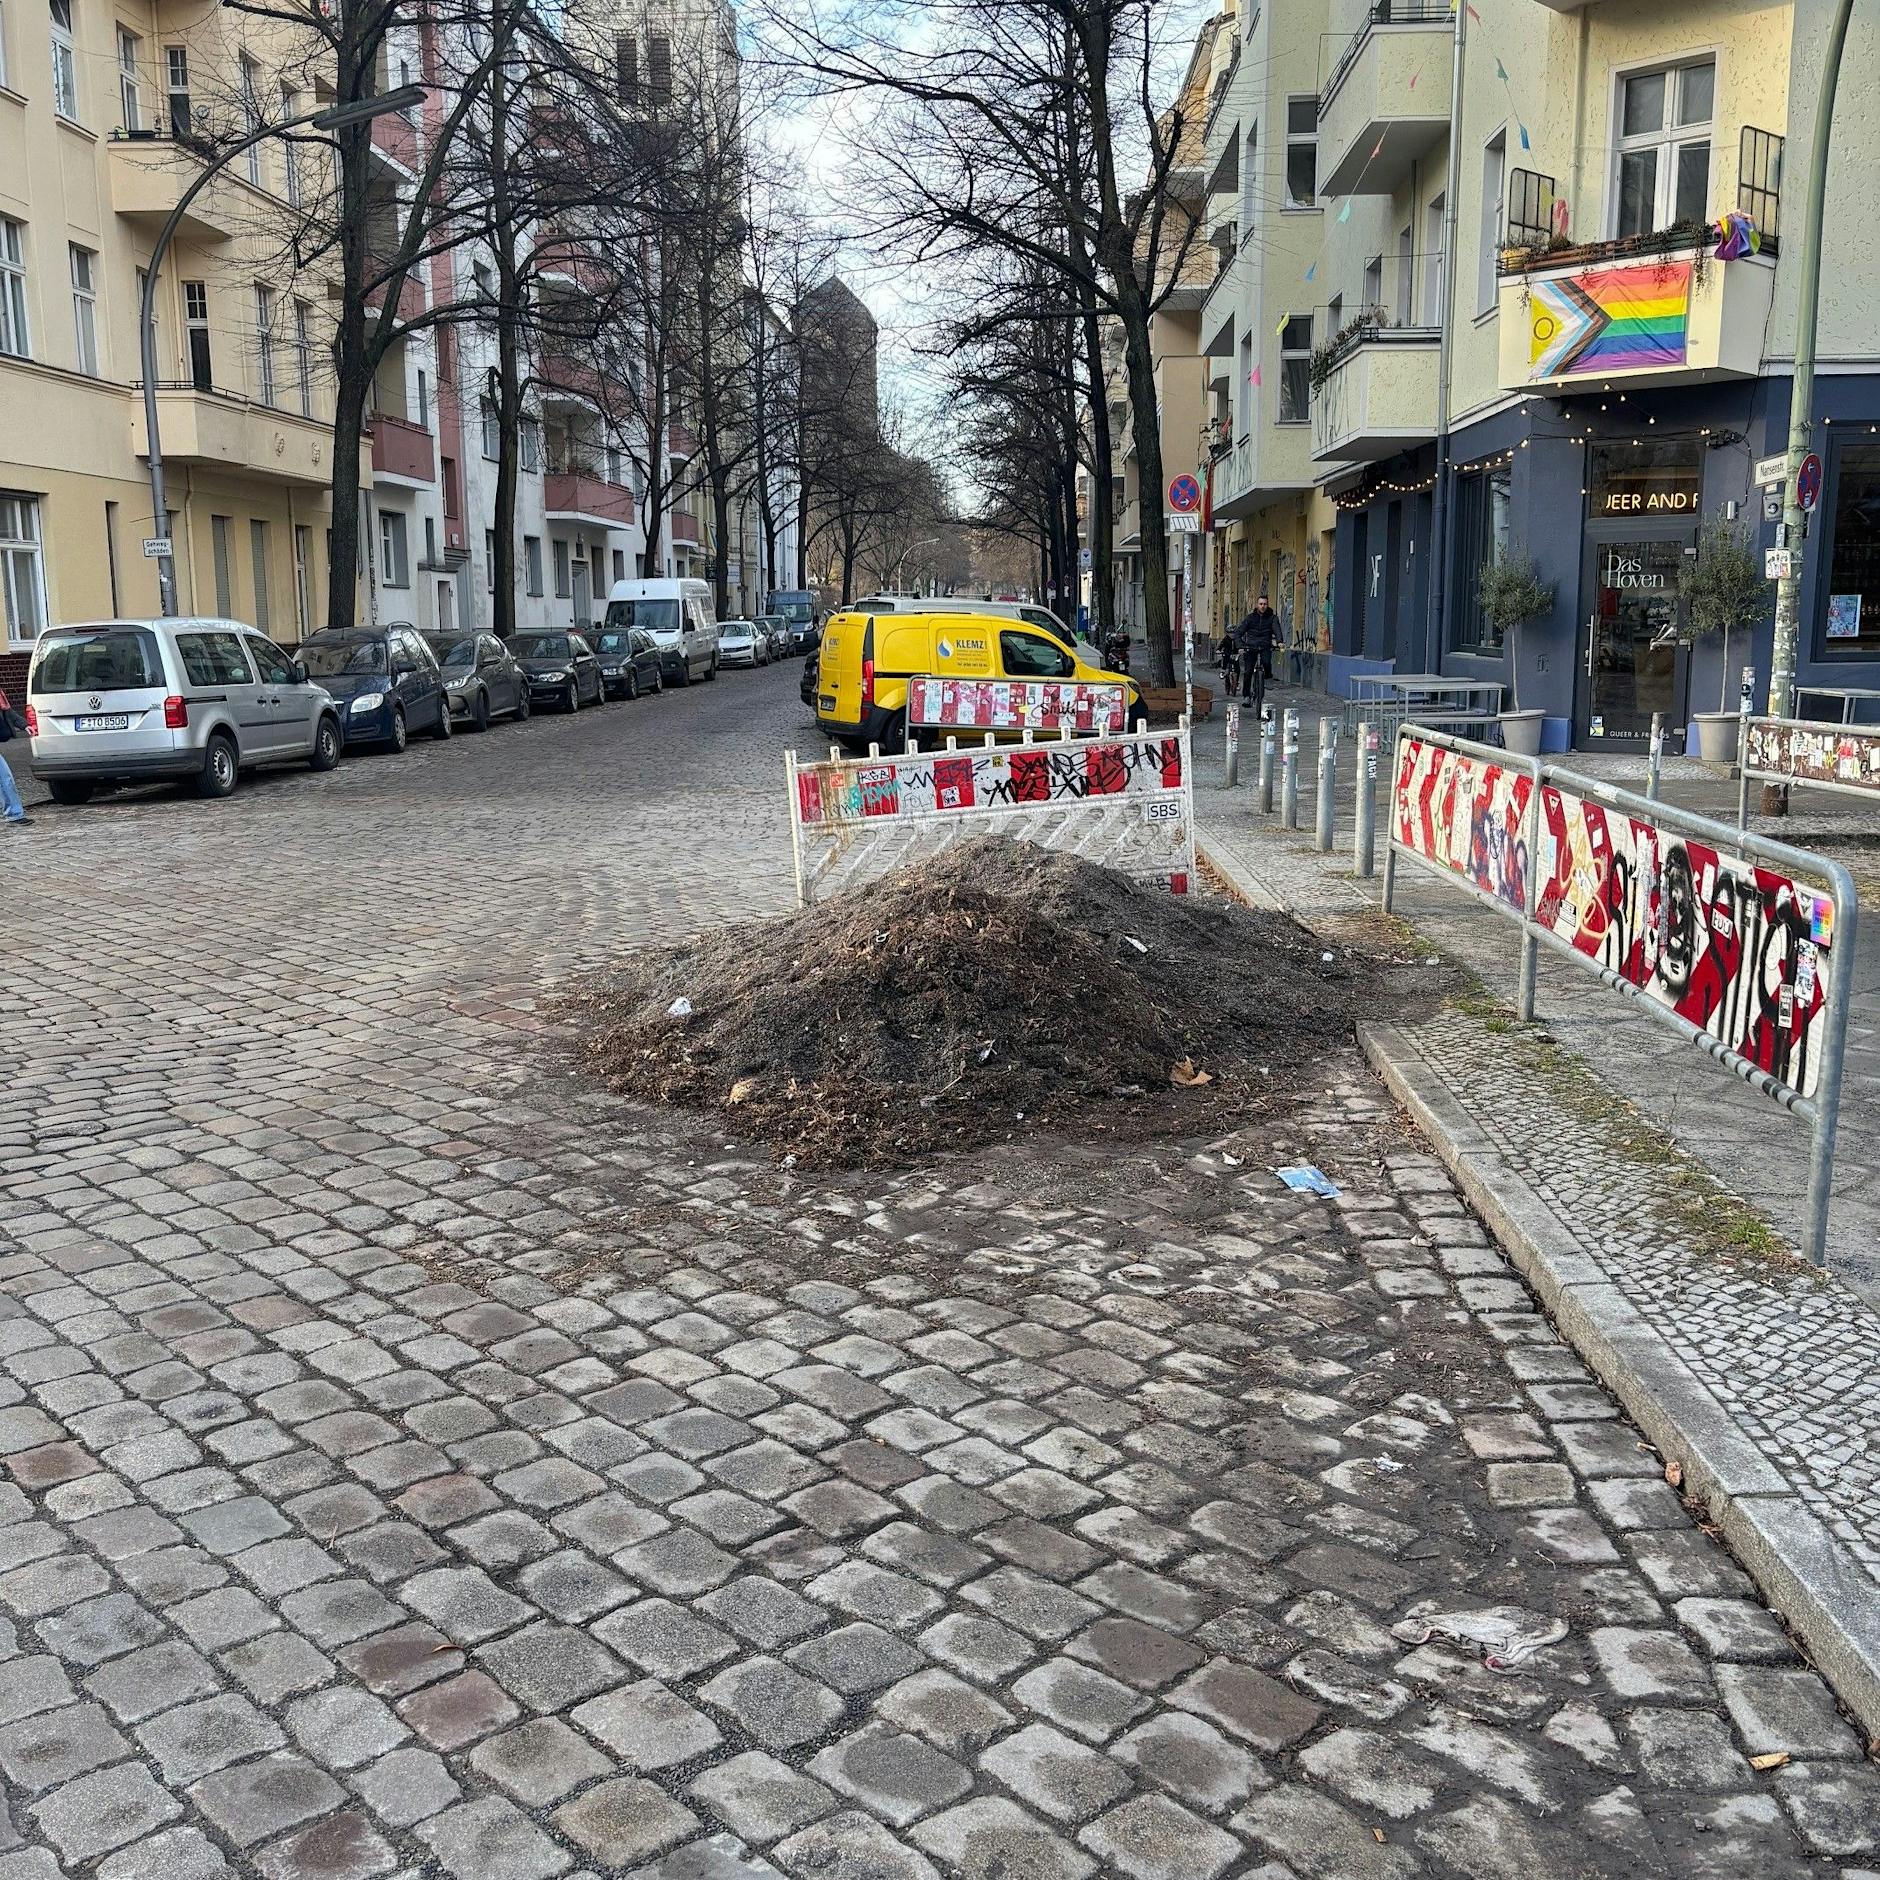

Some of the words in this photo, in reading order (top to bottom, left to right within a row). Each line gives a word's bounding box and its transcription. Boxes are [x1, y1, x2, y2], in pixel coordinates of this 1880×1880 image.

[1646, 493, 1687, 509] AND
[1606, 549, 1642, 573] Das
[1606, 571, 1665, 588] Hoven
[104, 715, 126, 726] 8506
[1609, 730, 1632, 738] QUEER
[1150, 803, 1178, 818] SBS
